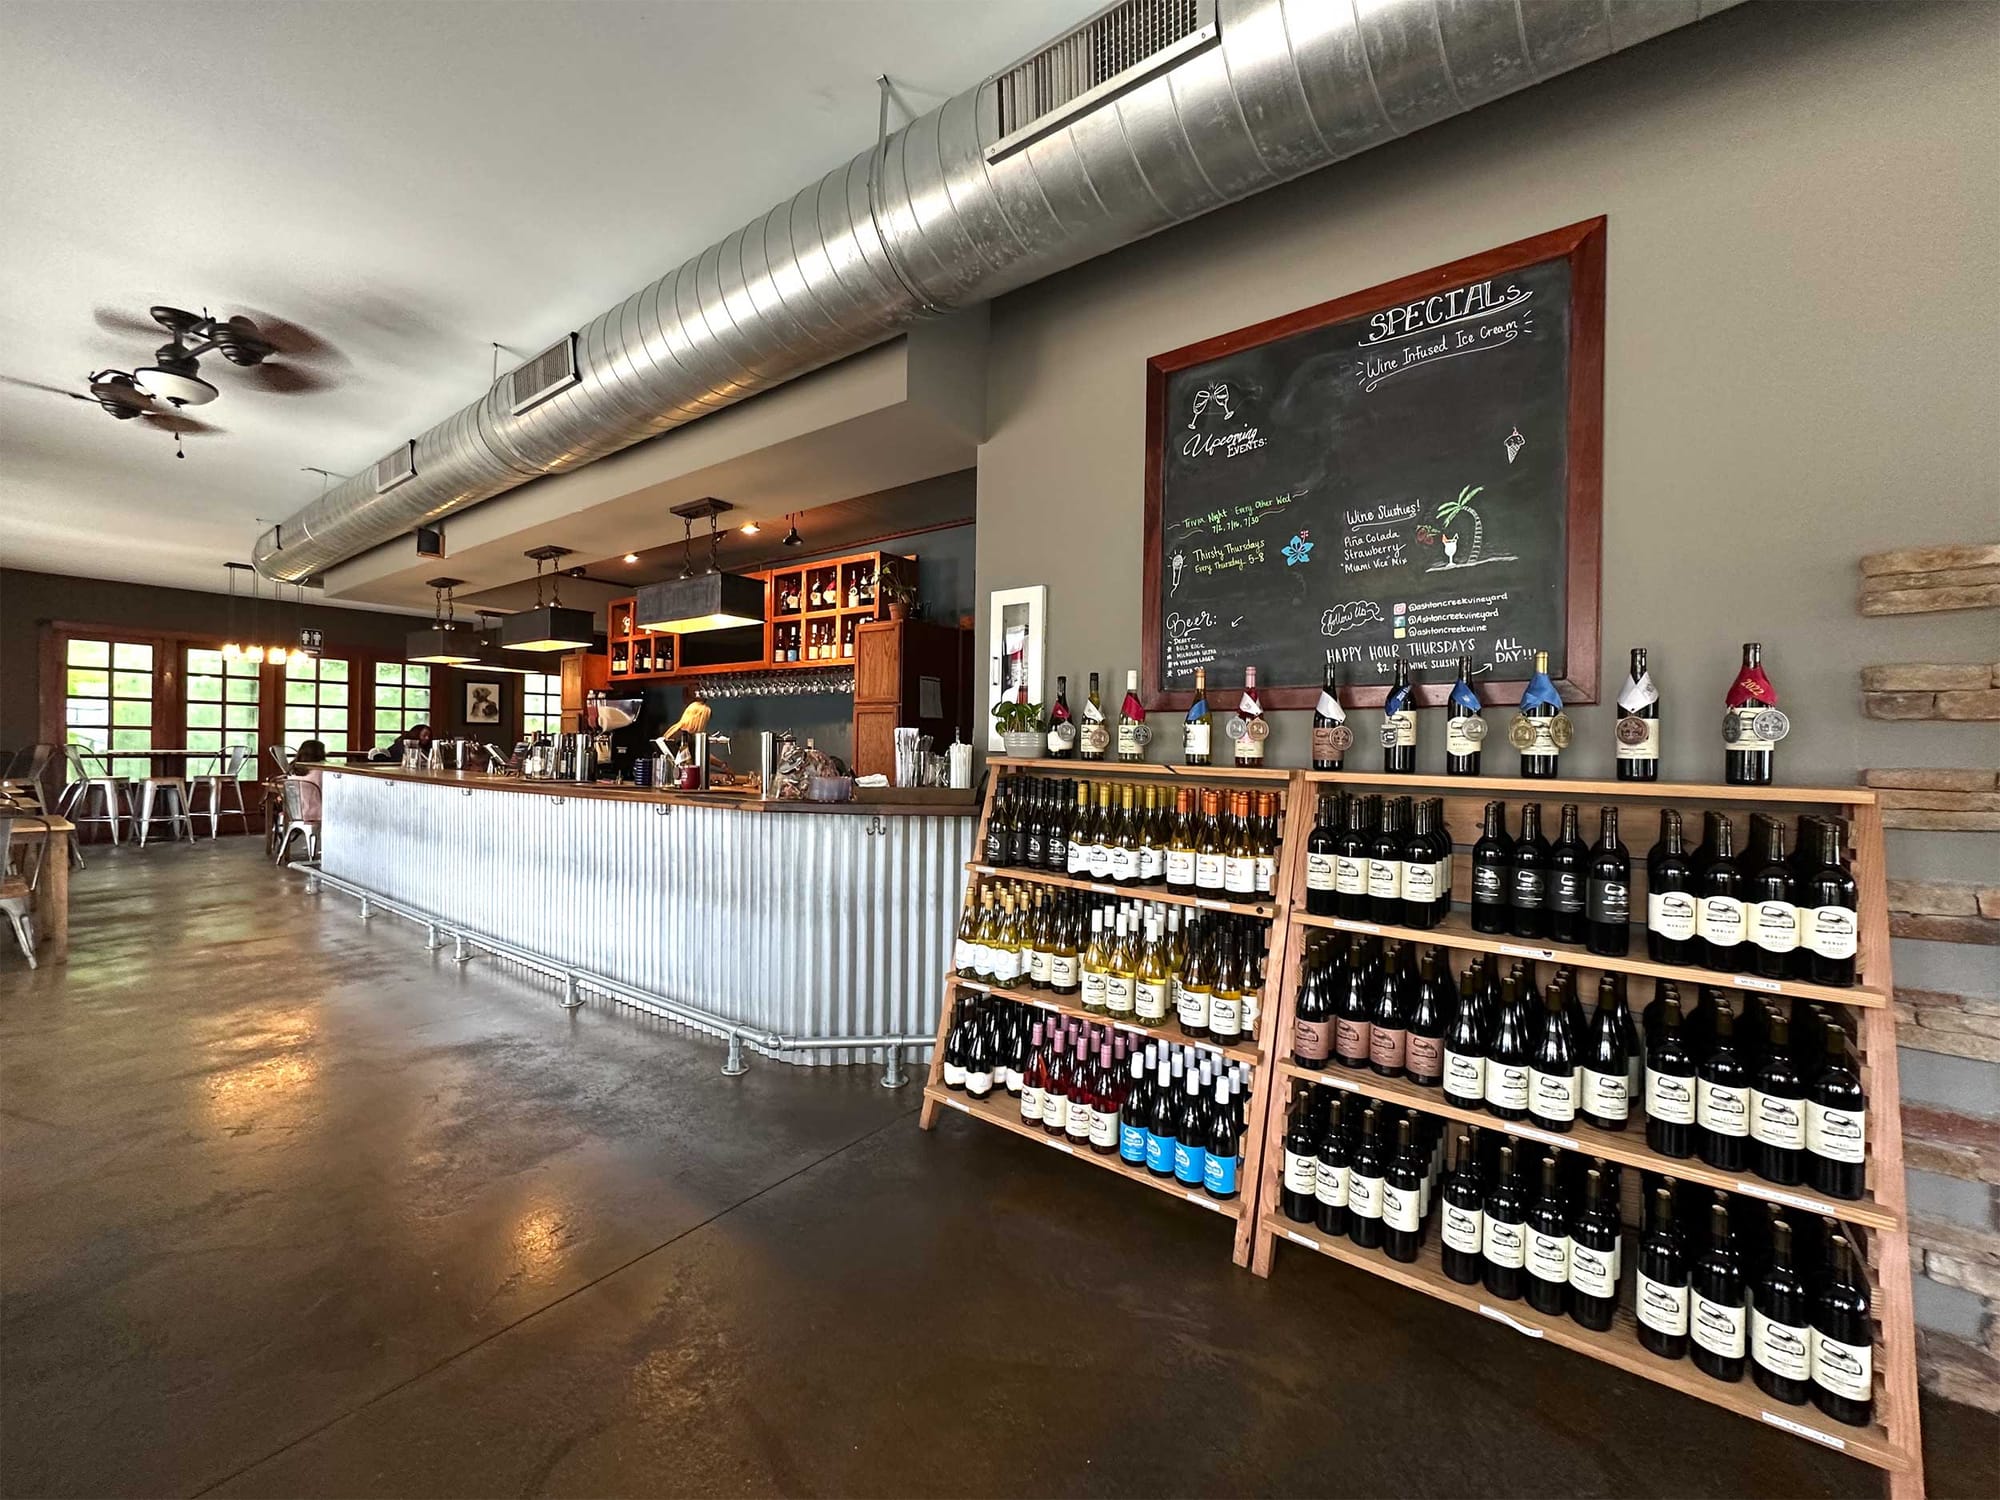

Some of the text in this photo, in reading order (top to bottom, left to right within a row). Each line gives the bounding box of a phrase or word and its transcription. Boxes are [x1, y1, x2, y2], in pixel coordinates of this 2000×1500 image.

[1367, 319, 1519, 379] Wine Infused Ice Cream
[1183, 424, 1258, 457] Upcoming
[1207, 508, 1228, 524] Night
[1234, 505, 1253, 517] Every
[1254, 499, 1273, 509] Other
[1275, 493, 1292, 506] Wed
[1346, 499, 1420, 525] Wine Slushies!
[1344, 529, 1401, 548] Piña Colada
[1192, 538, 1266, 563] Thirsty Thursdays
[1344, 543, 1407, 561] Strawberry
[1194, 552, 1265, 576] Every Thursday 5-8
[1391, 557, 1408, 567] Mix
[1408, 592, 1508, 612] @ashtoncreekvineyard
[1166, 610, 1217, 638] Beer:
[1408, 624, 1488, 637] @ashtoncreekwine
[1326, 638, 1476, 664] HAPPY HOUR THURSDAYS
[1495, 637, 1522, 651] ALL
[1377, 661, 1390, 674] $2
[1408, 660, 1428, 671] WINE
[1431, 658, 1460, 669] SLUSHY
[1740, 678, 1765, 696] 2022
